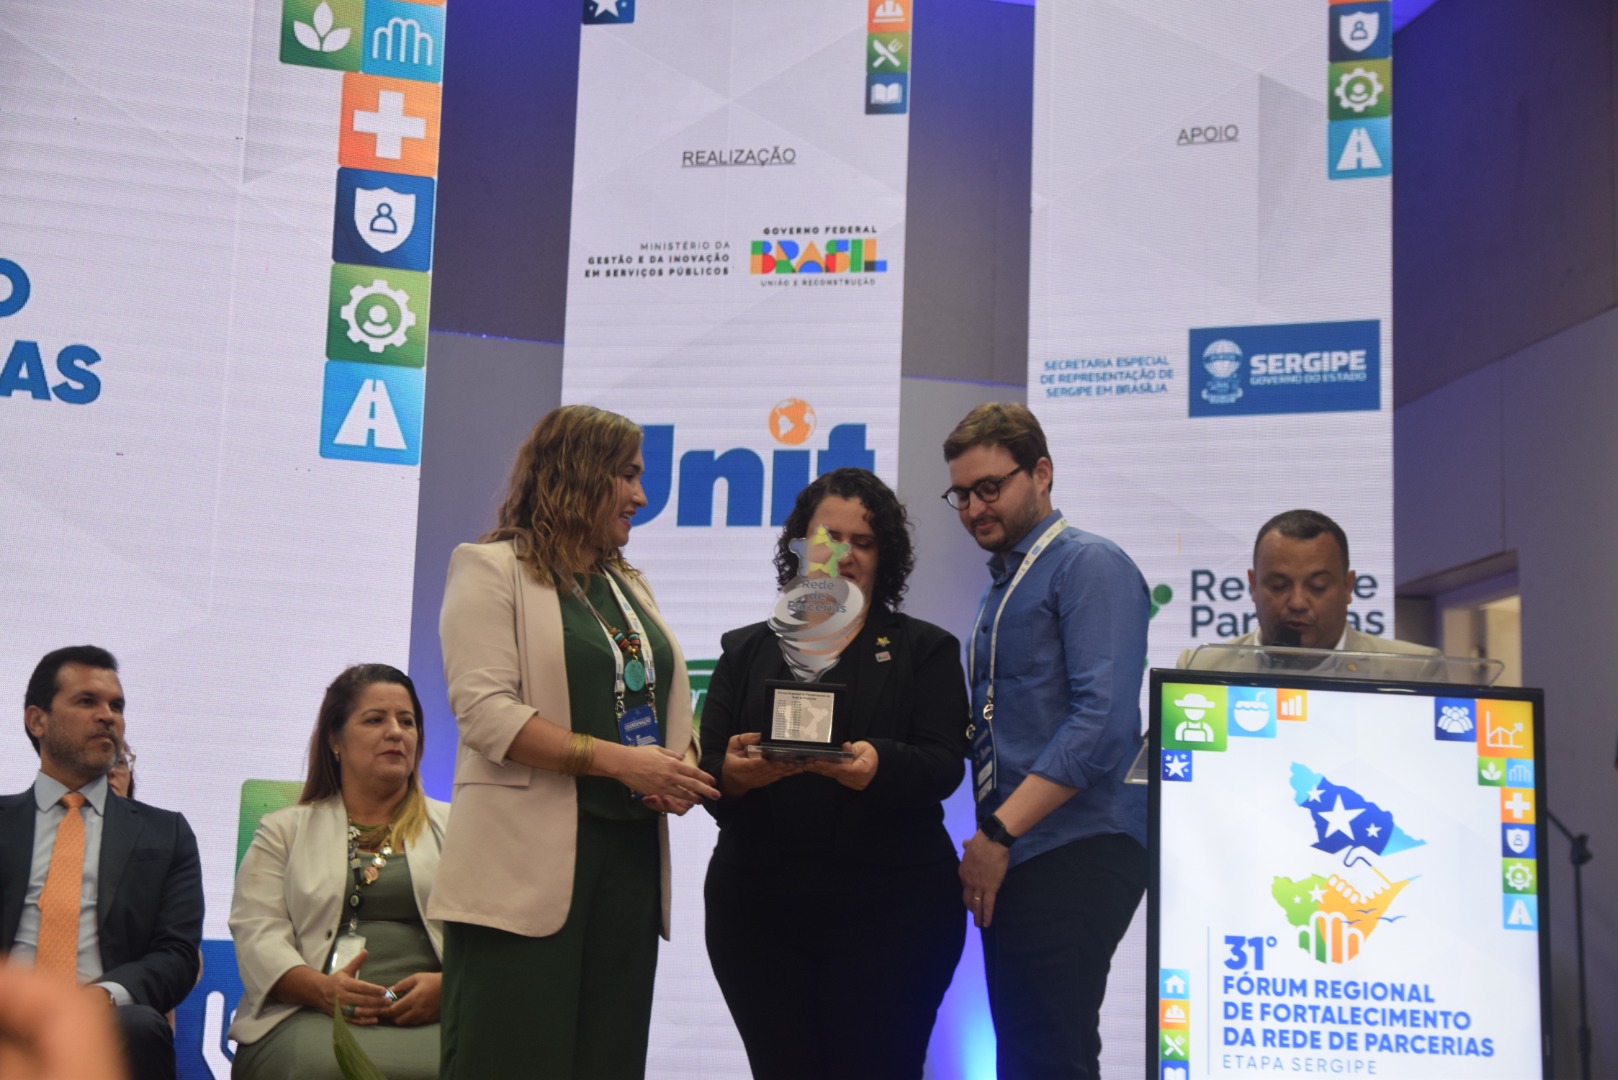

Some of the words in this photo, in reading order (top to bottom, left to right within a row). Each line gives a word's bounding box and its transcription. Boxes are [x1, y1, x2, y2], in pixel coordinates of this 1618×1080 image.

[1177, 124, 1239, 145] APOIO
[682, 146, 796, 167] REALIZAÇÃO
[763, 227, 820, 235] GOVERNO
[825, 226, 877, 234] FEDERAL
[640, 240, 710, 251] MINISTÉRIO
[715, 241, 730, 250] DA
[588, 253, 633, 265] GESTÃO
[638, 255, 644, 264] E
[649, 255, 664, 264] DA
[669, 251, 730, 264] INOVAÇÃO
[750, 238, 888, 274] BRASIL
[585, 269, 600, 278] EM
[605, 268, 664, 278] SERVIÇOS
[669, 266, 729, 276] PÚBLICOS
[761, 278, 790, 287] UNIÃO
[802, 277, 876, 287] RECONSTRUÇÃO
[1044, 358, 1113, 370] SECRETARIA
[1116, 355, 1170, 368] ESPECIAL
[1250, 349, 1368, 375] SERGIPE
[1040, 374, 1055, 384] DE
[1058, 368, 1156, 382] REPRESENTAÇÃO
[1159, 369, 1174, 379] DE
[1250, 374, 1302, 386] GOVERNO
[1304, 373, 1320, 384] DO
[1322, 371, 1367, 383] ESTADO
[1046, 385, 1093, 397] SERGIPE
[1096, 384, 1113, 396] EM
[1116, 381, 1168, 395] BRASÍLIA
[801, 578, 834, 590] Rede
[1191, 569, 1256, 602] Re
[809, 590, 825, 600] de
[787, 600, 847, 613] Parcerias
[1223, 935, 1278, 971] 31°
[1223, 971, 1308, 998] FÓRUM
[1314, 979, 1436, 1004] REGIONAL
[1223, 1001, 1254, 1021] DE
[1260, 1003, 1472, 1031] FORTALECIMENTO
[1223, 1027, 1256, 1047] DA
[1262, 1028, 1322, 1050] REDE
[1328, 1031, 1359, 1051] DE
[1364, 1033, 1495, 1058] PARCERIAS
[1223, 1054, 1285, 1071] ETAPA
[1291, 1057, 1377, 1076] SERGIPE
